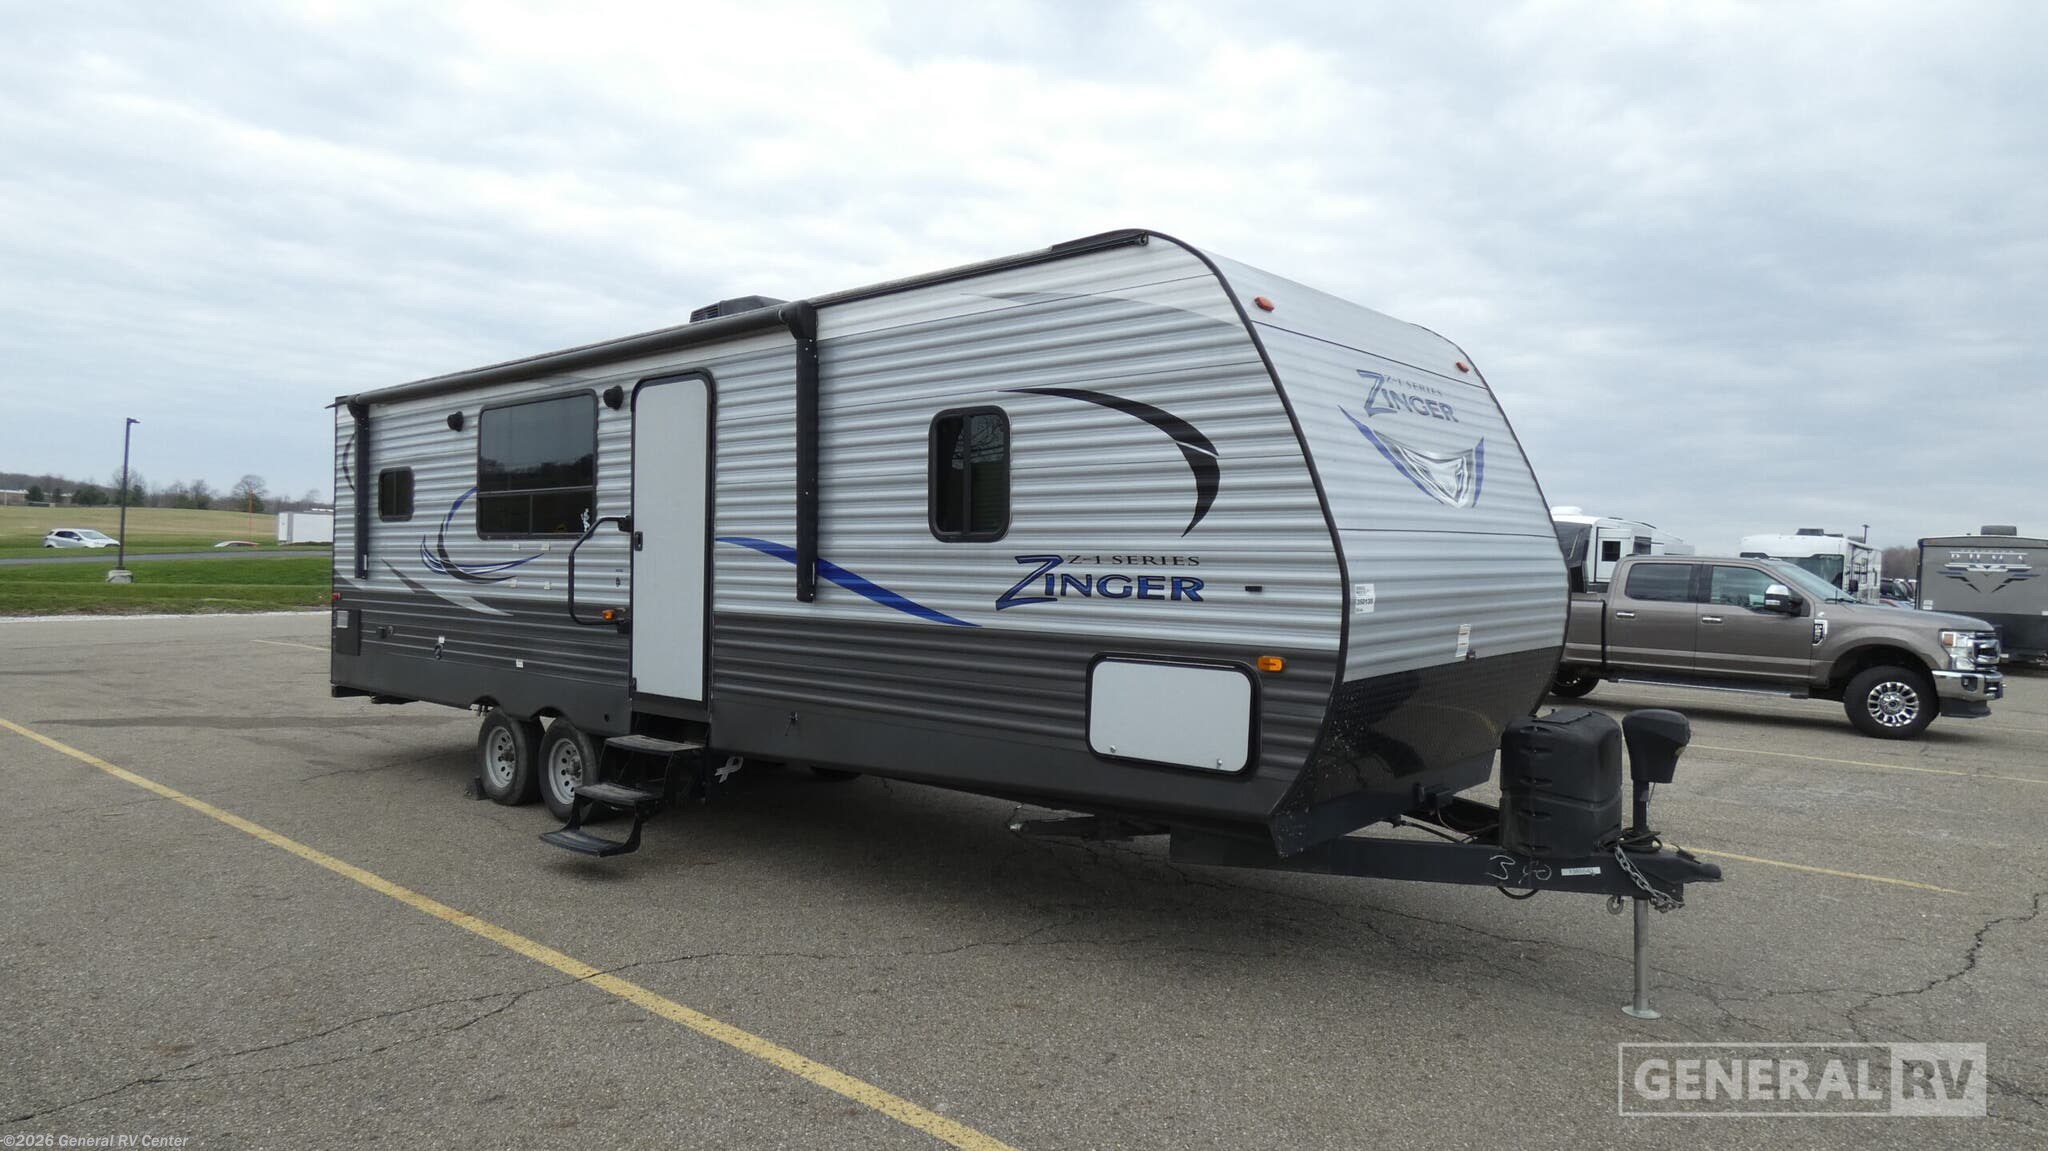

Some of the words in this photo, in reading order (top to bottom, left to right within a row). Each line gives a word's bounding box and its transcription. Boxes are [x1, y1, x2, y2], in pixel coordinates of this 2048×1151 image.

[1356, 369, 1460, 423] ZINGER
[1406, 381, 1443, 396] SERIES
[1068, 555, 1100, 564] Z-1
[1112, 555, 1200, 567] SERIES
[996, 554, 1204, 611] ZINGER
